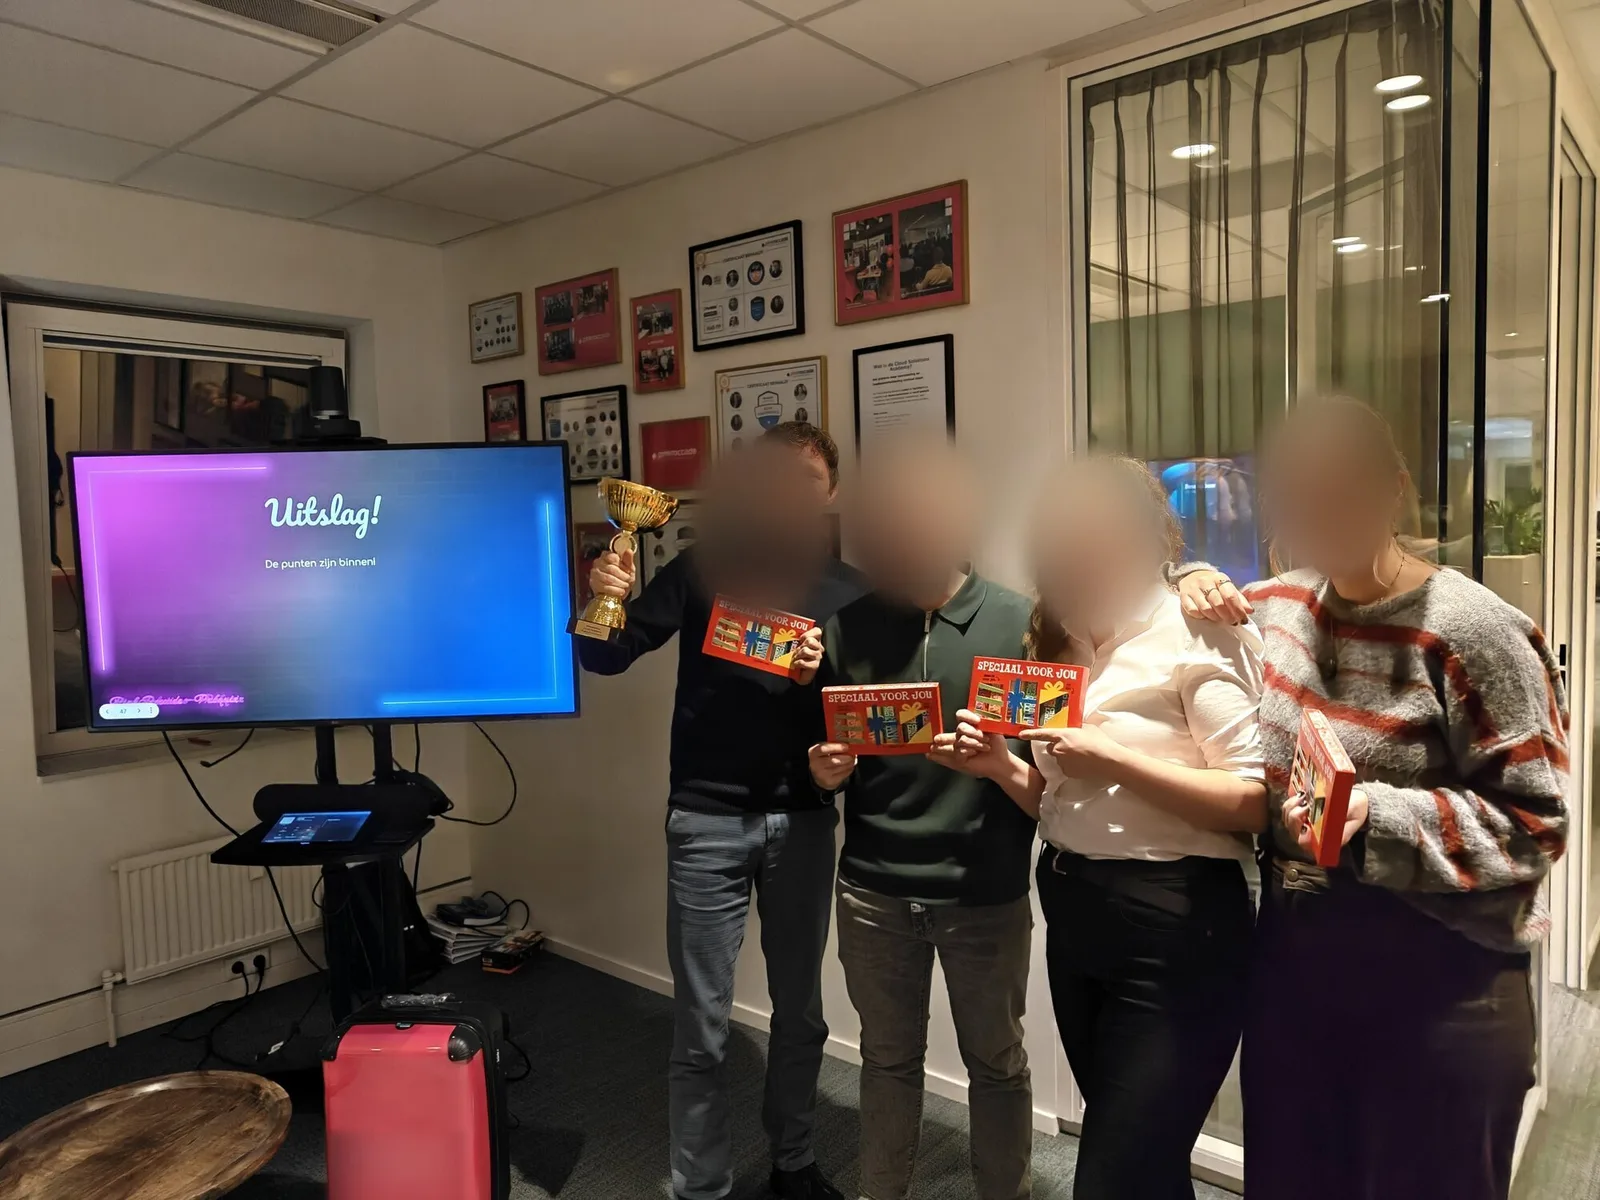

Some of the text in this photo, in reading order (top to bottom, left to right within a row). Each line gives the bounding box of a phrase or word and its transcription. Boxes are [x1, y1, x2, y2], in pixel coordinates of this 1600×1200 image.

[264, 493, 382, 540] Uitslag!
[265, 559, 279, 569] De
[281, 558, 317, 571] punten
[319, 557, 337, 569] zijn
[718, 599, 809, 632] SPECIAAL VOOR JOU
[977, 660, 1078, 680] SPECIAAL VOOR JOU
[828, 690, 933, 703] SPECIAAL VOOR JOU
